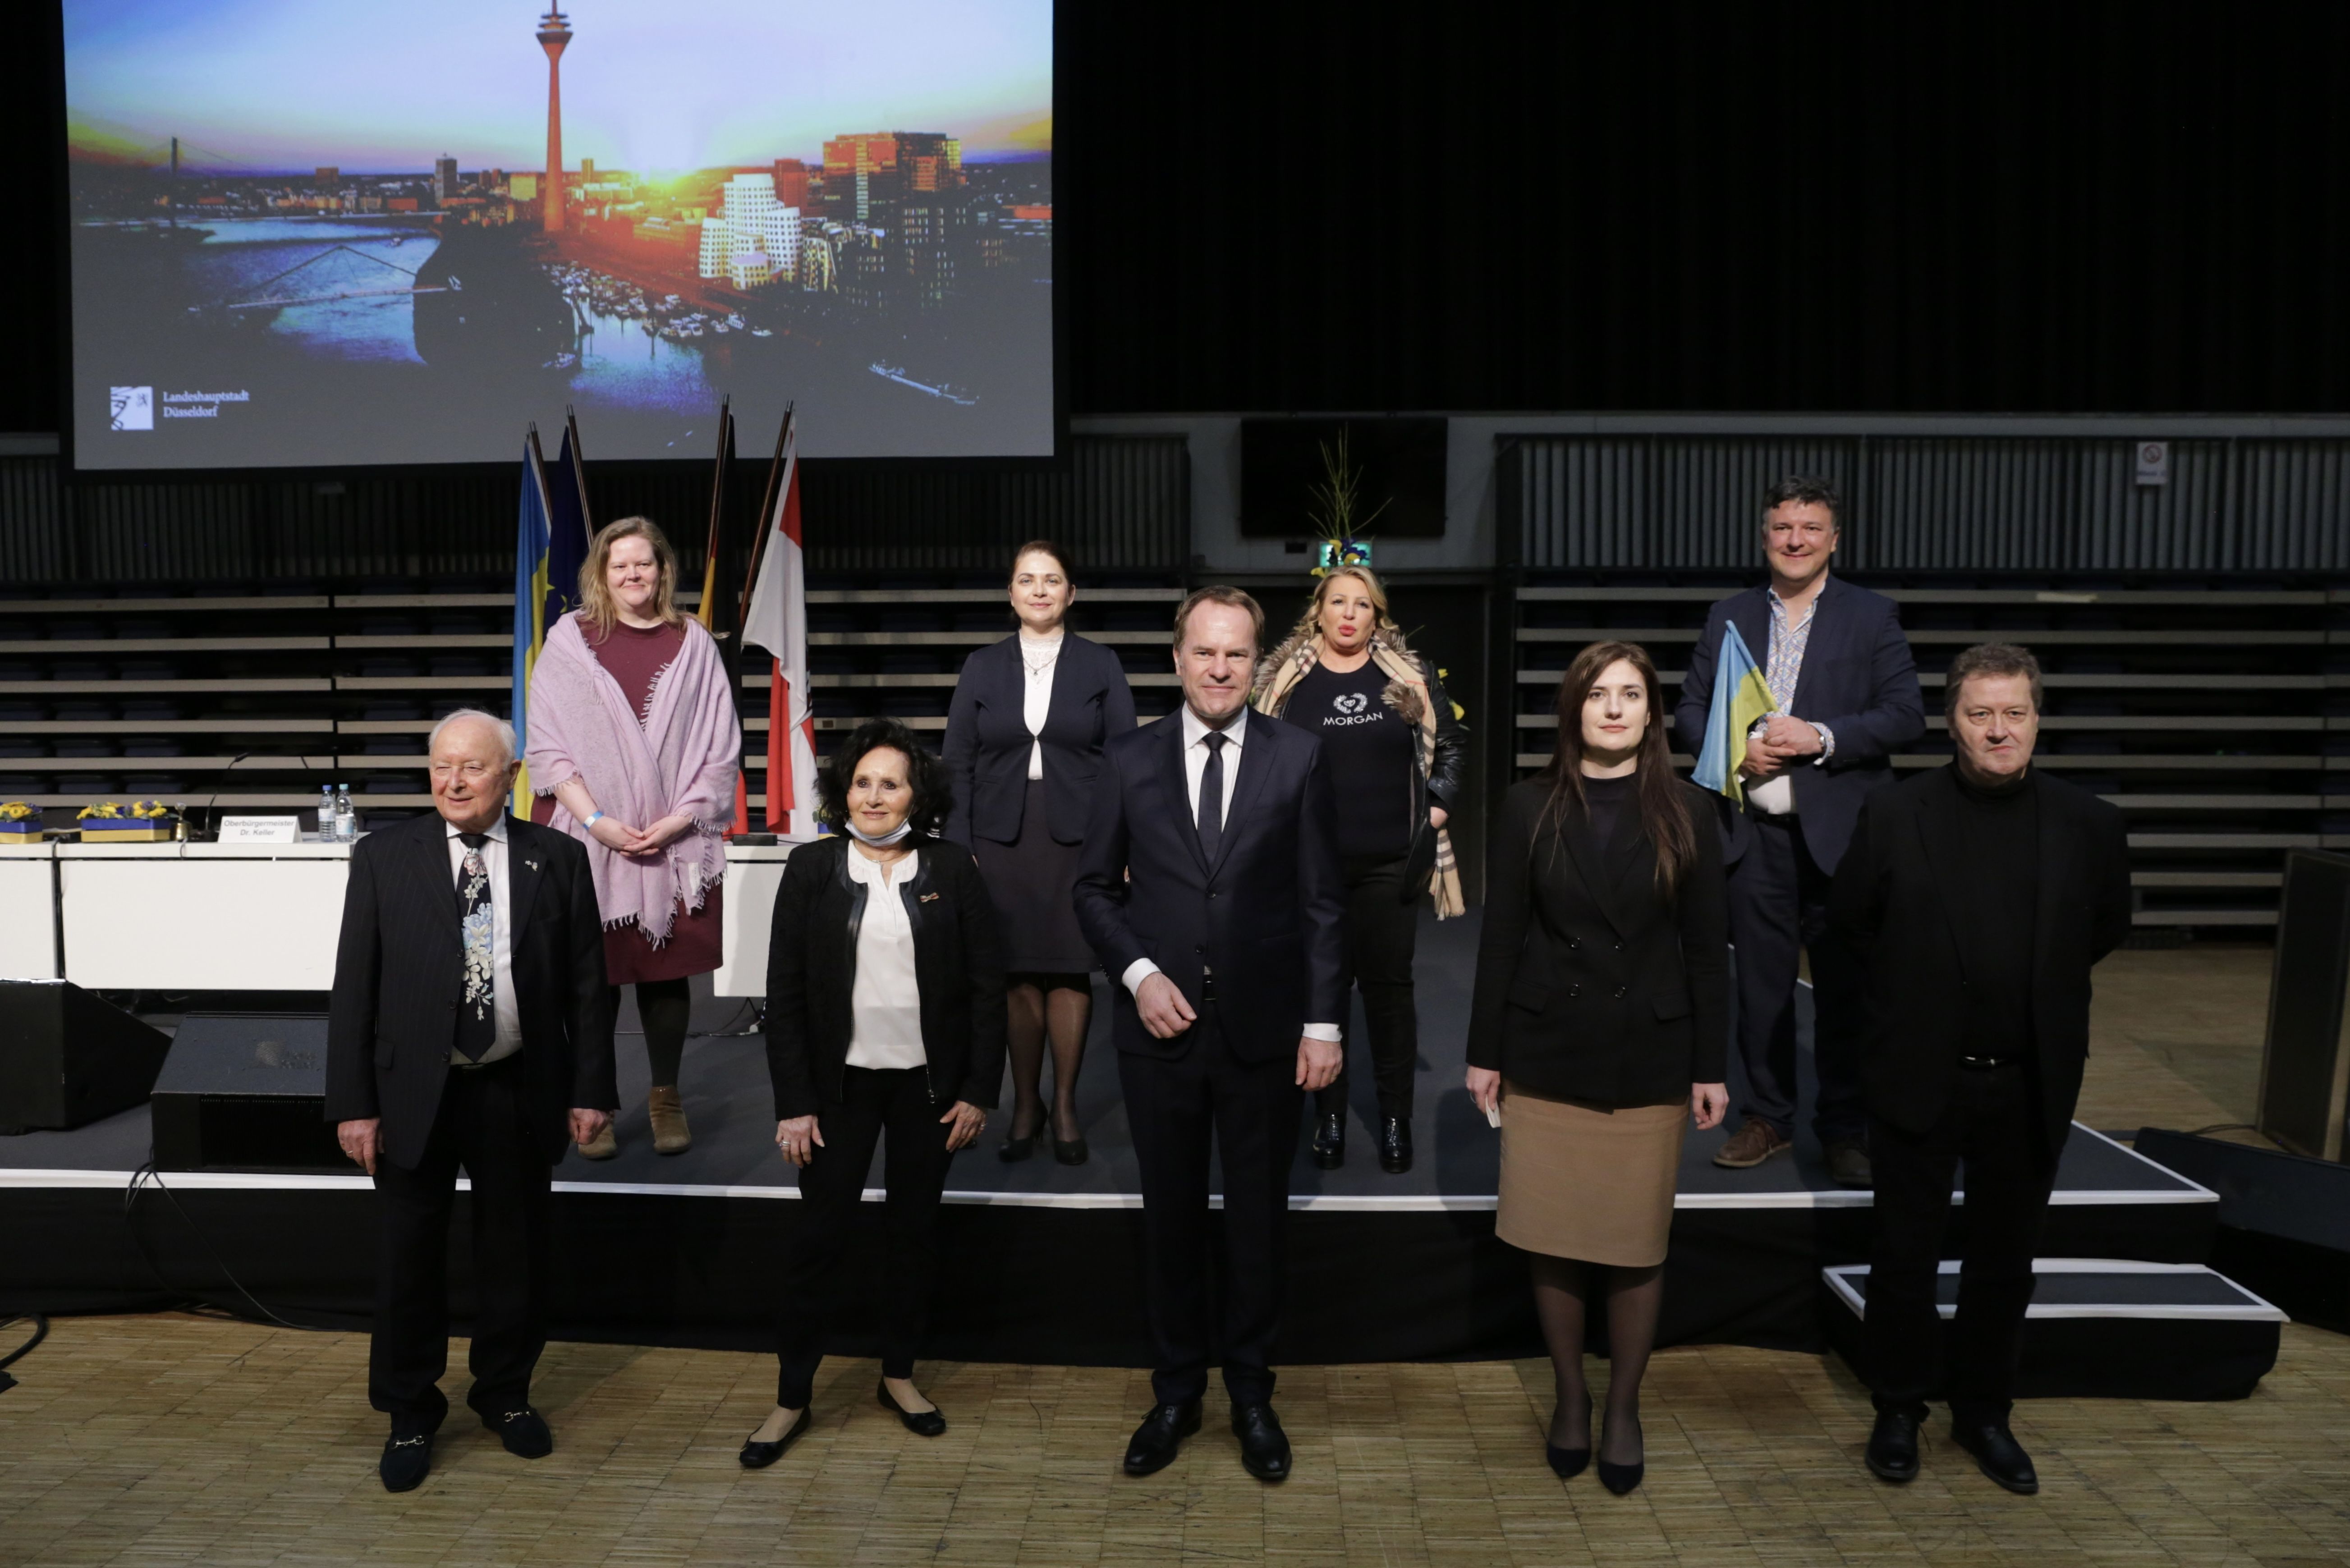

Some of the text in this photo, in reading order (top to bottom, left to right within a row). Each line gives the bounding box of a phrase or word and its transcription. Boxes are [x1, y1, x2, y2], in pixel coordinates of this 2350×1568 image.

[163, 390, 249, 404] Landeshauptstadt
[163, 405, 218, 417] Düsseldorf
[1323, 711, 1383, 726] MORGAN
